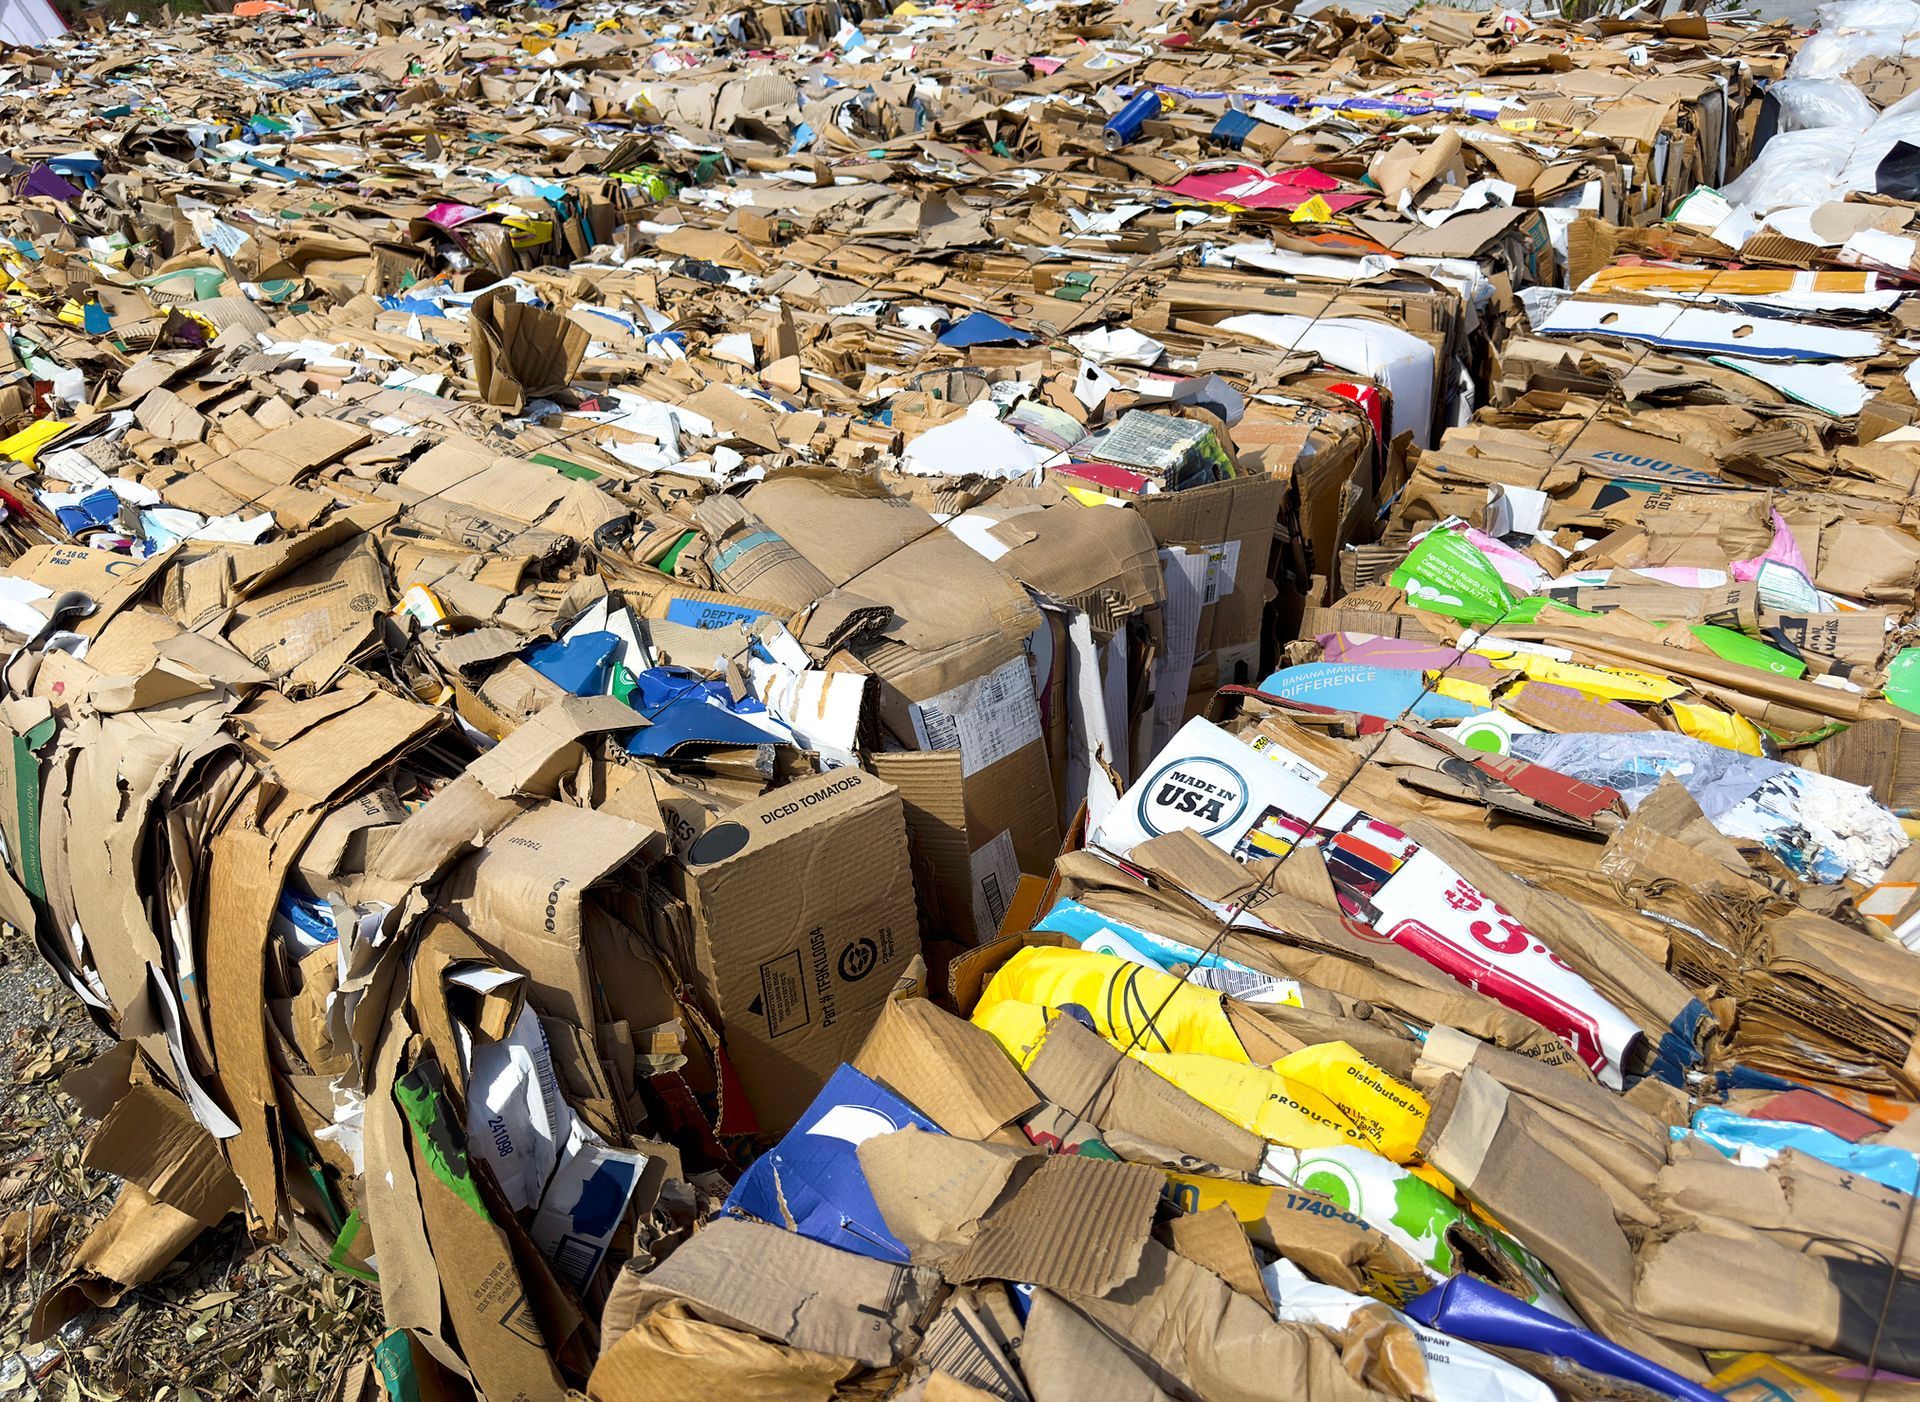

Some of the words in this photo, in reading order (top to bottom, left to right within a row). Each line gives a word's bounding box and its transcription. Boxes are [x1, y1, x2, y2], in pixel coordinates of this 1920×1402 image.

[50, 558, 72, 566] PKGS
[1460, 572, 1480, 588] Ricardo
[702, 609, 735, 620] DEPT
[1282, 670, 1324, 686] BANANA
[1282, 672, 1376, 698] DIFFERENCE
[1170, 771, 1216, 793] MADE
[1217, 789, 1236, 801] IN
[760, 802, 800, 825] DICED
[800, 775, 862, 808] TOMATOES
[1156, 783, 1225, 823] USA
[820, 994, 834, 1005] #
[822, 1004, 836, 1028] Part
[1347, 1066, 1408, 1108] Distributed
[1408, 1104, 1425, 1119] by:
[1269, 1093, 1342, 1130] PRODUCT
[1346, 1129, 1368, 1140] OF
[488, 1116, 514, 1157] 241098
[1286, 1194, 1370, 1231] 1740-04
[873, 1320, 882, 1332] 3
